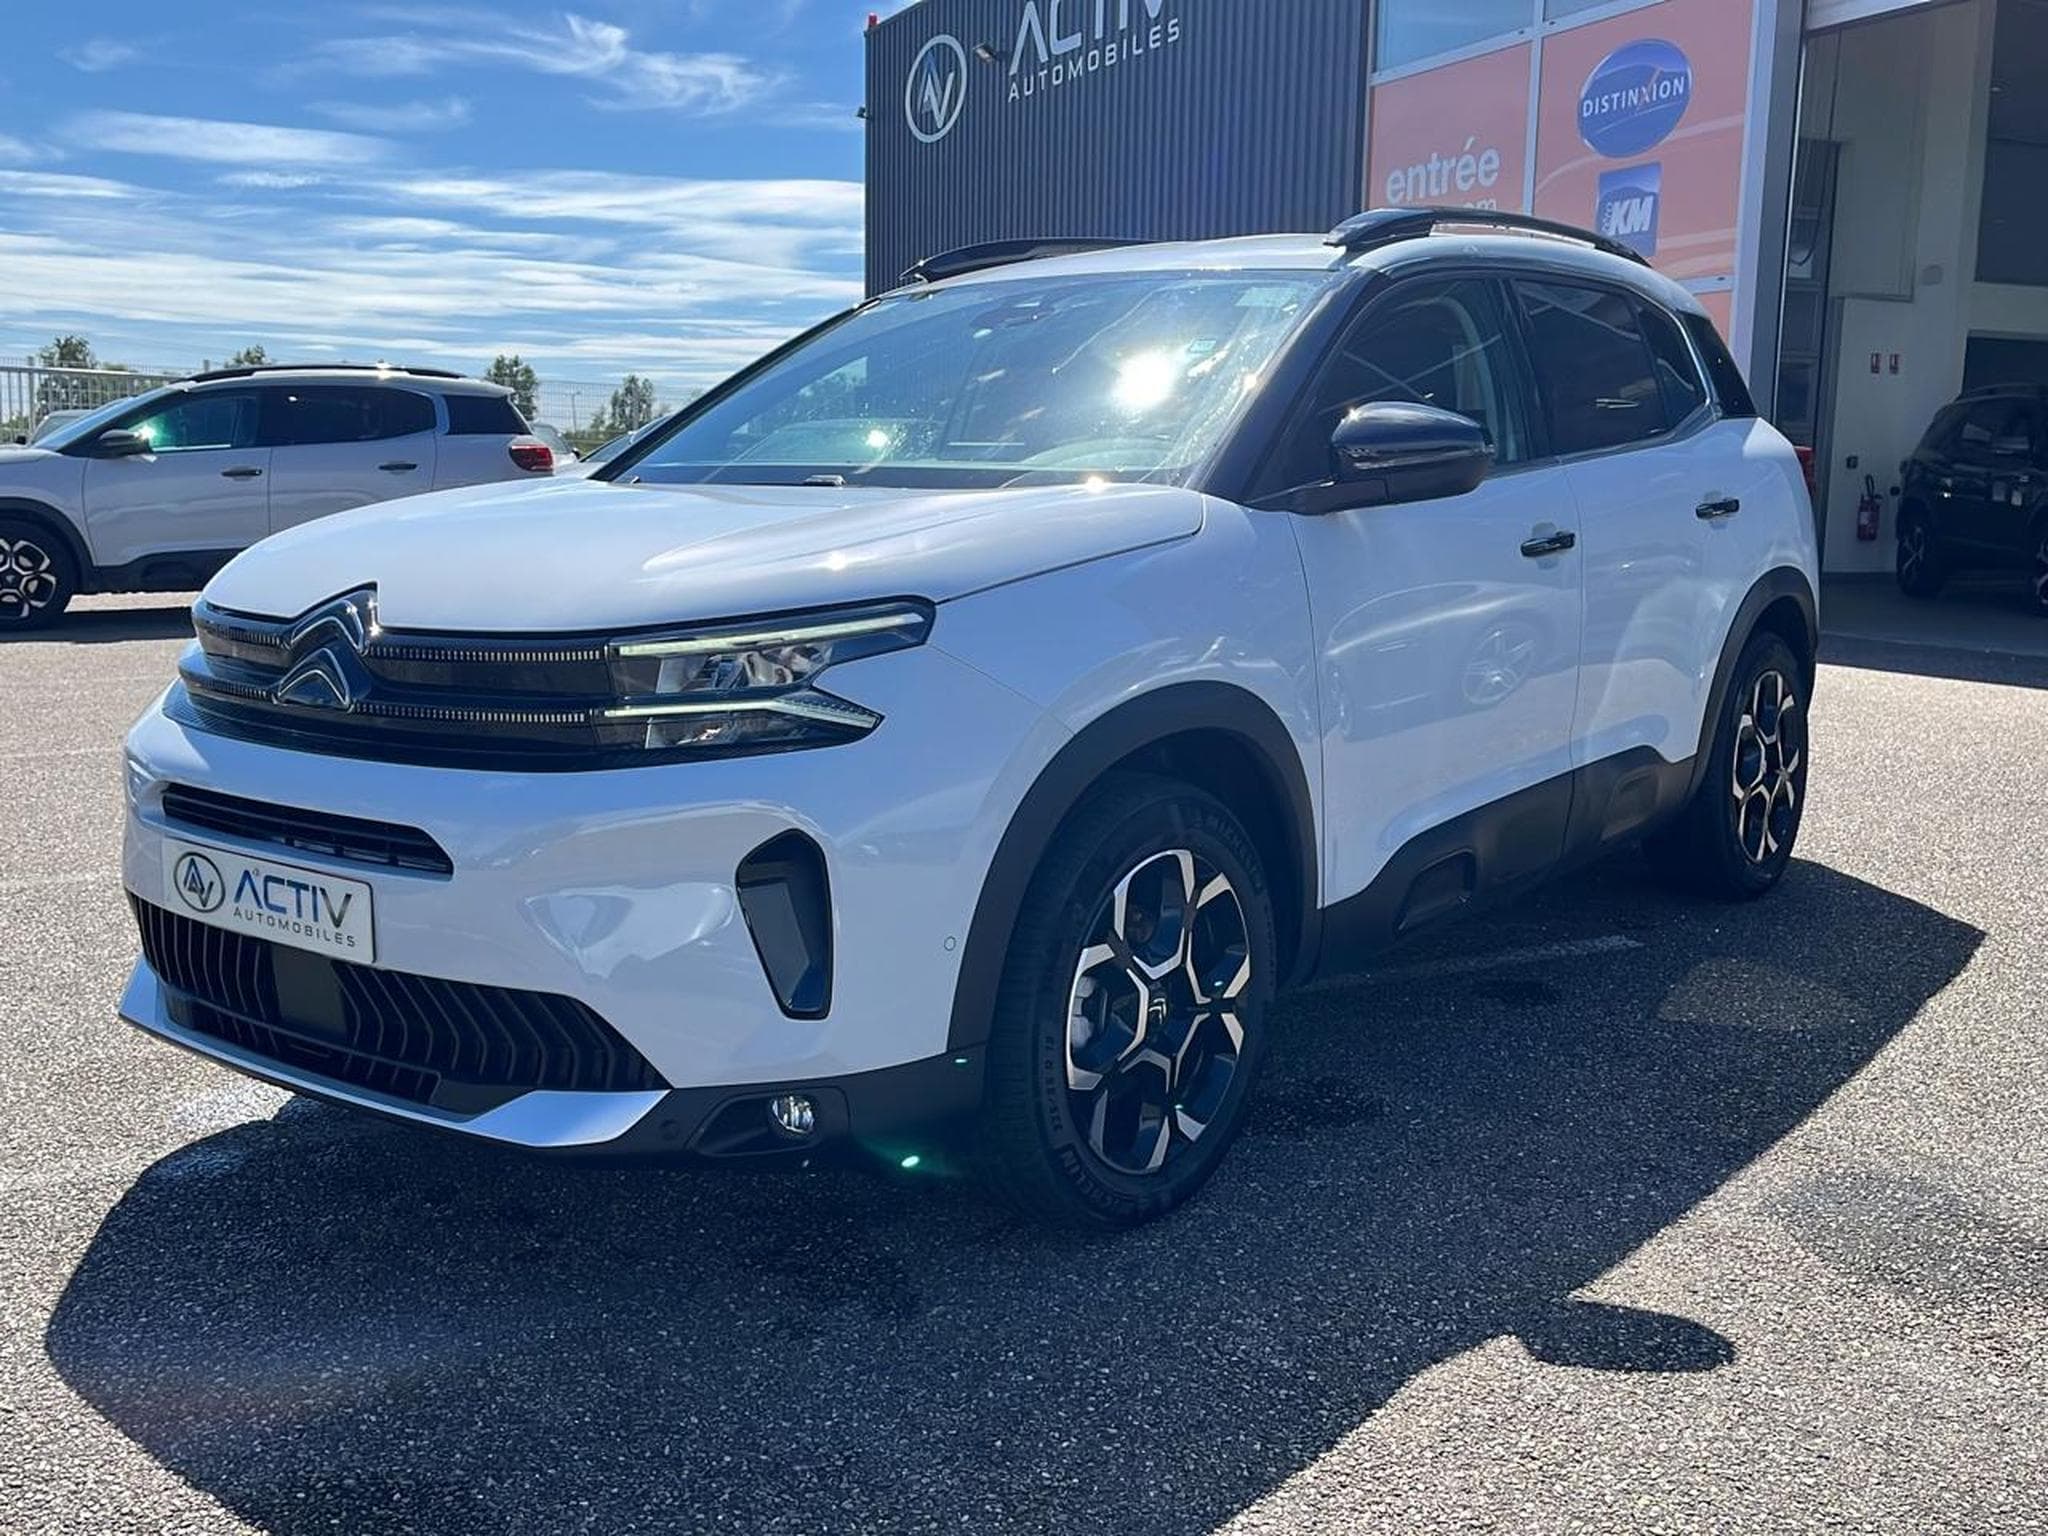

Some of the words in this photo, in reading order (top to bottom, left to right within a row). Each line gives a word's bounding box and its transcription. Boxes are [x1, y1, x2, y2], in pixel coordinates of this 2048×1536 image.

[1007, 18, 1181, 103] AUTOMOBILES
[1583, 74, 1685, 118] DISTINXION
[1386, 136, 1500, 207] entrée
[1607, 195, 1654, 237] KM
[234, 869, 353, 928] ACTIV
[233, 906, 356, 948] AUTOMOBILES
